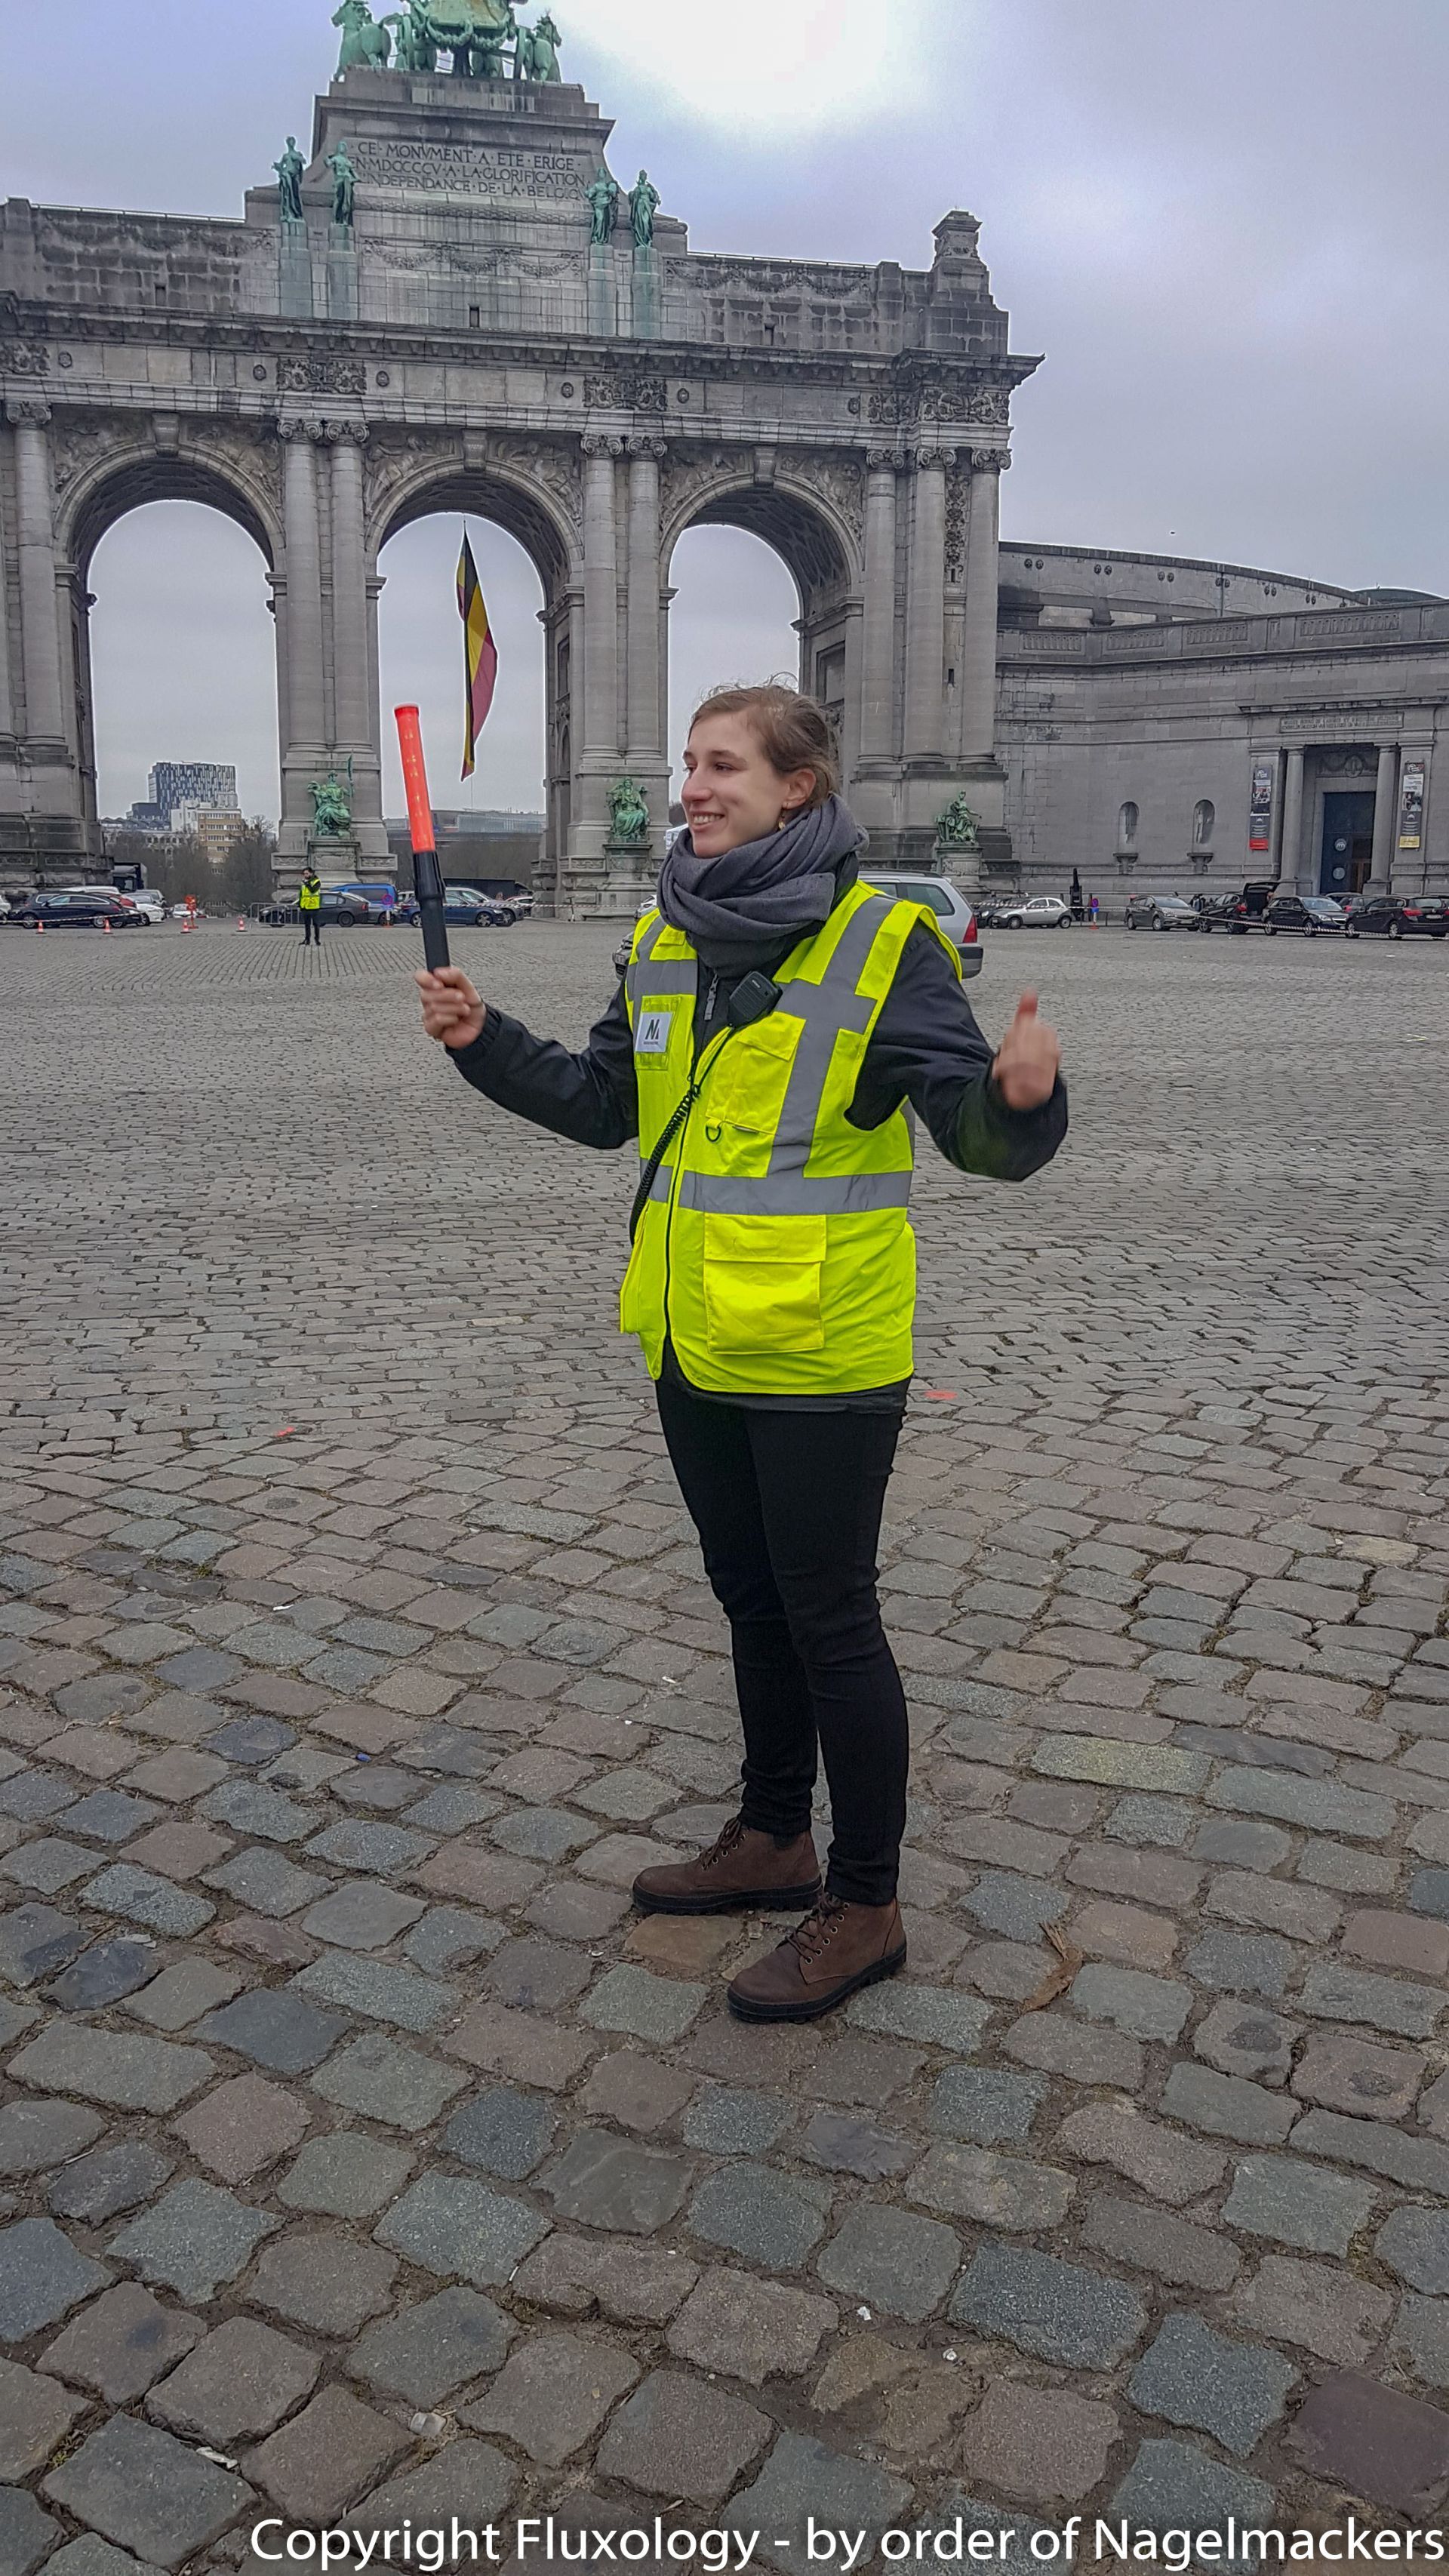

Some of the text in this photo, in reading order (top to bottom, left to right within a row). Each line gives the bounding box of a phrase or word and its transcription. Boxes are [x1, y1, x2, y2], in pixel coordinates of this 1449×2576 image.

[358, 142, 377, 155] CE
[478, 152, 490, 165] A
[497, 152, 525, 167] ETE
[534, 155, 574, 171] ERIGE
[445, 165, 457, 177] A
[463, 165, 481, 178] LA
[483, 168, 585, 186] GLORIFICATION
[478, 181, 497, 194] DE
[503, 183, 521, 195] LA
